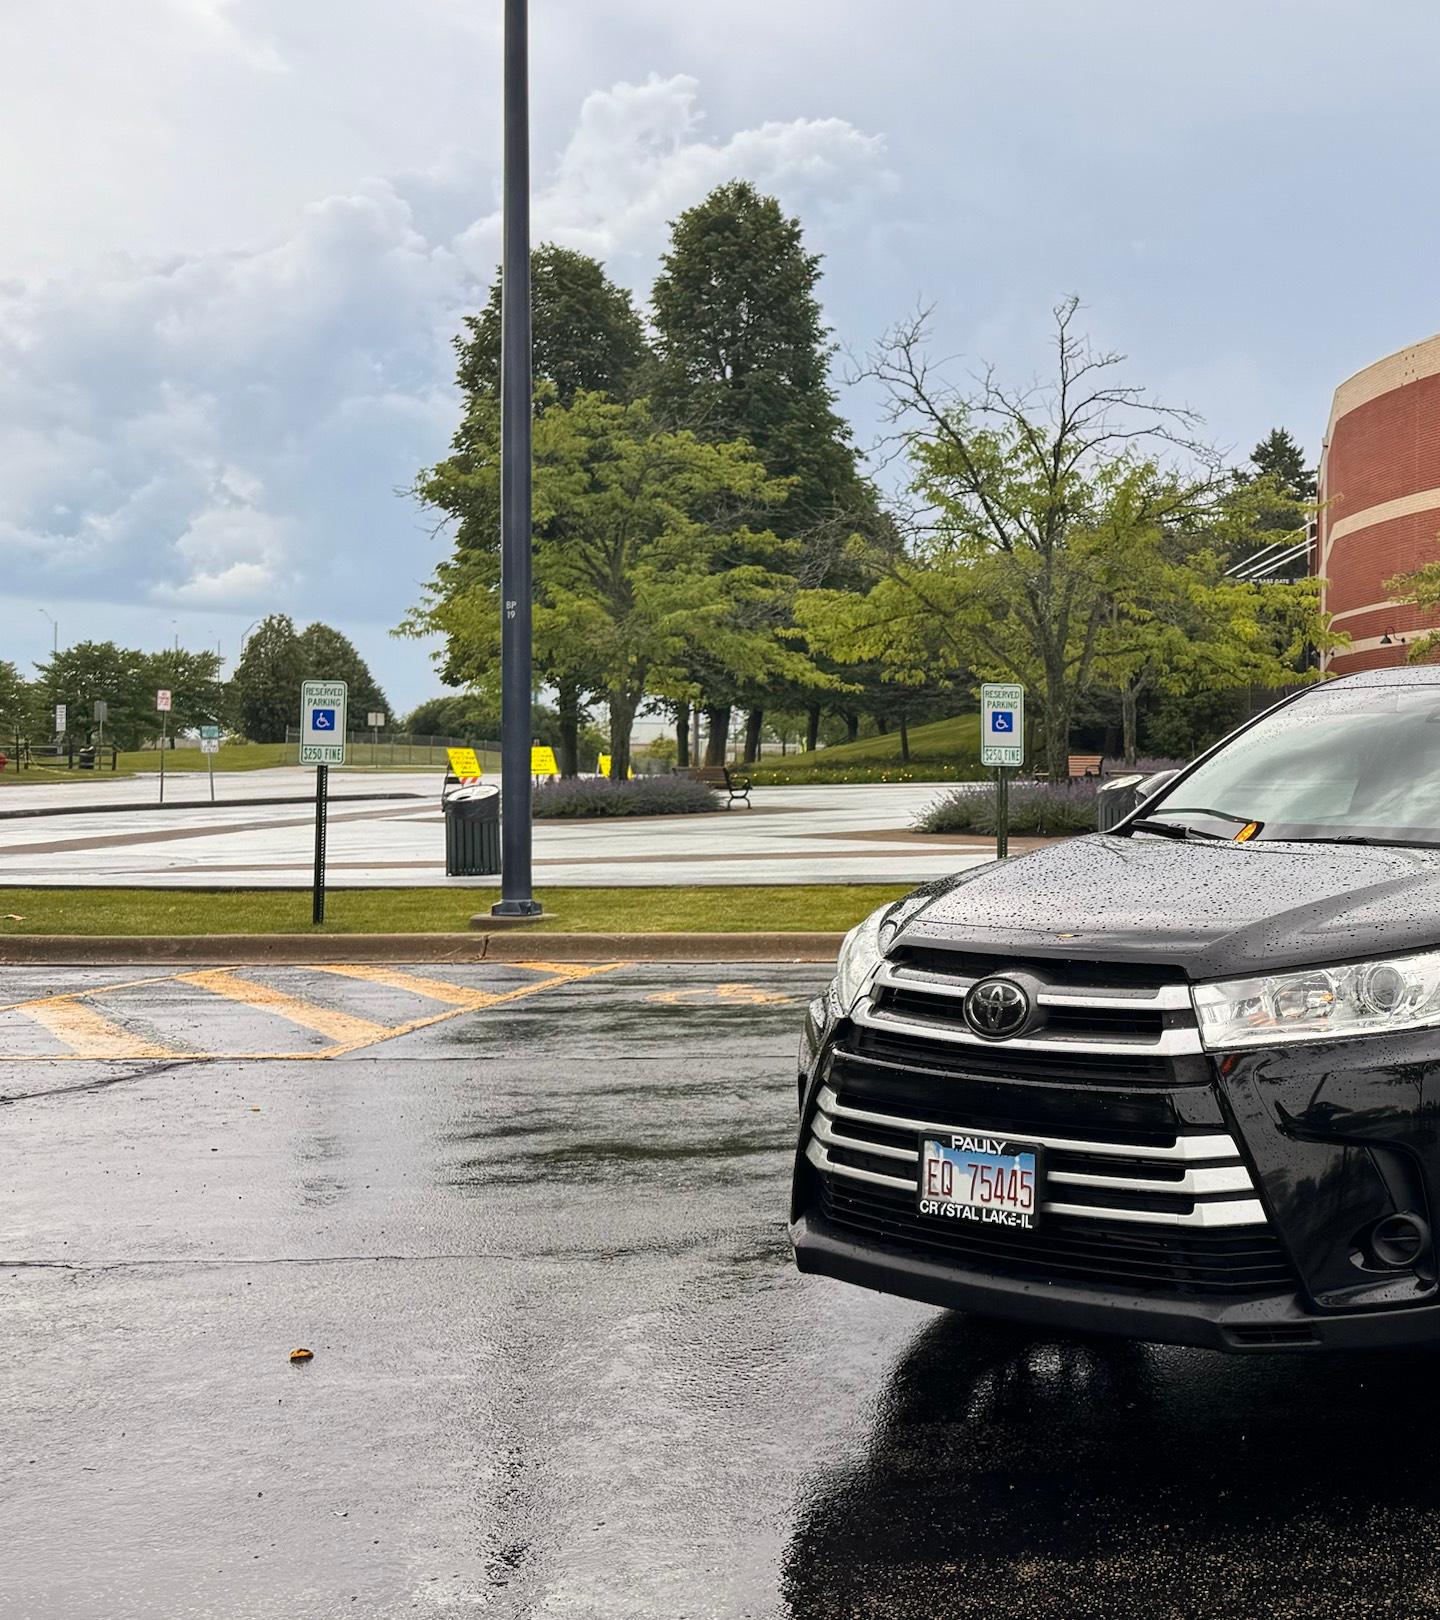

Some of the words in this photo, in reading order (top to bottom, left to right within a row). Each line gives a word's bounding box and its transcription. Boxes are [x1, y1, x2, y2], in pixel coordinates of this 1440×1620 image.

[506, 601, 517, 609] BP
[507, 610, 516, 619] 19
[306, 687, 343, 697] RESERVED
[985, 690, 1020, 699] RESERVED
[308, 698, 341, 707] PARKING
[987, 700, 1018, 709] PARKING
[304, 748, 322, 760] $250
[325, 748, 341, 761] FINE
[985, 748, 1003, 761] $250
[1004, 749, 1020, 761] FINE
[951, 1135, 1007, 1155] PAULY
[927, 1159, 954, 1198] EQ
[967, 1163, 1033, 1209] 75445
[919, 1199, 980, 1221] CRYSTAL
[982, 1208, 1033, 1229] LAKE-IL
